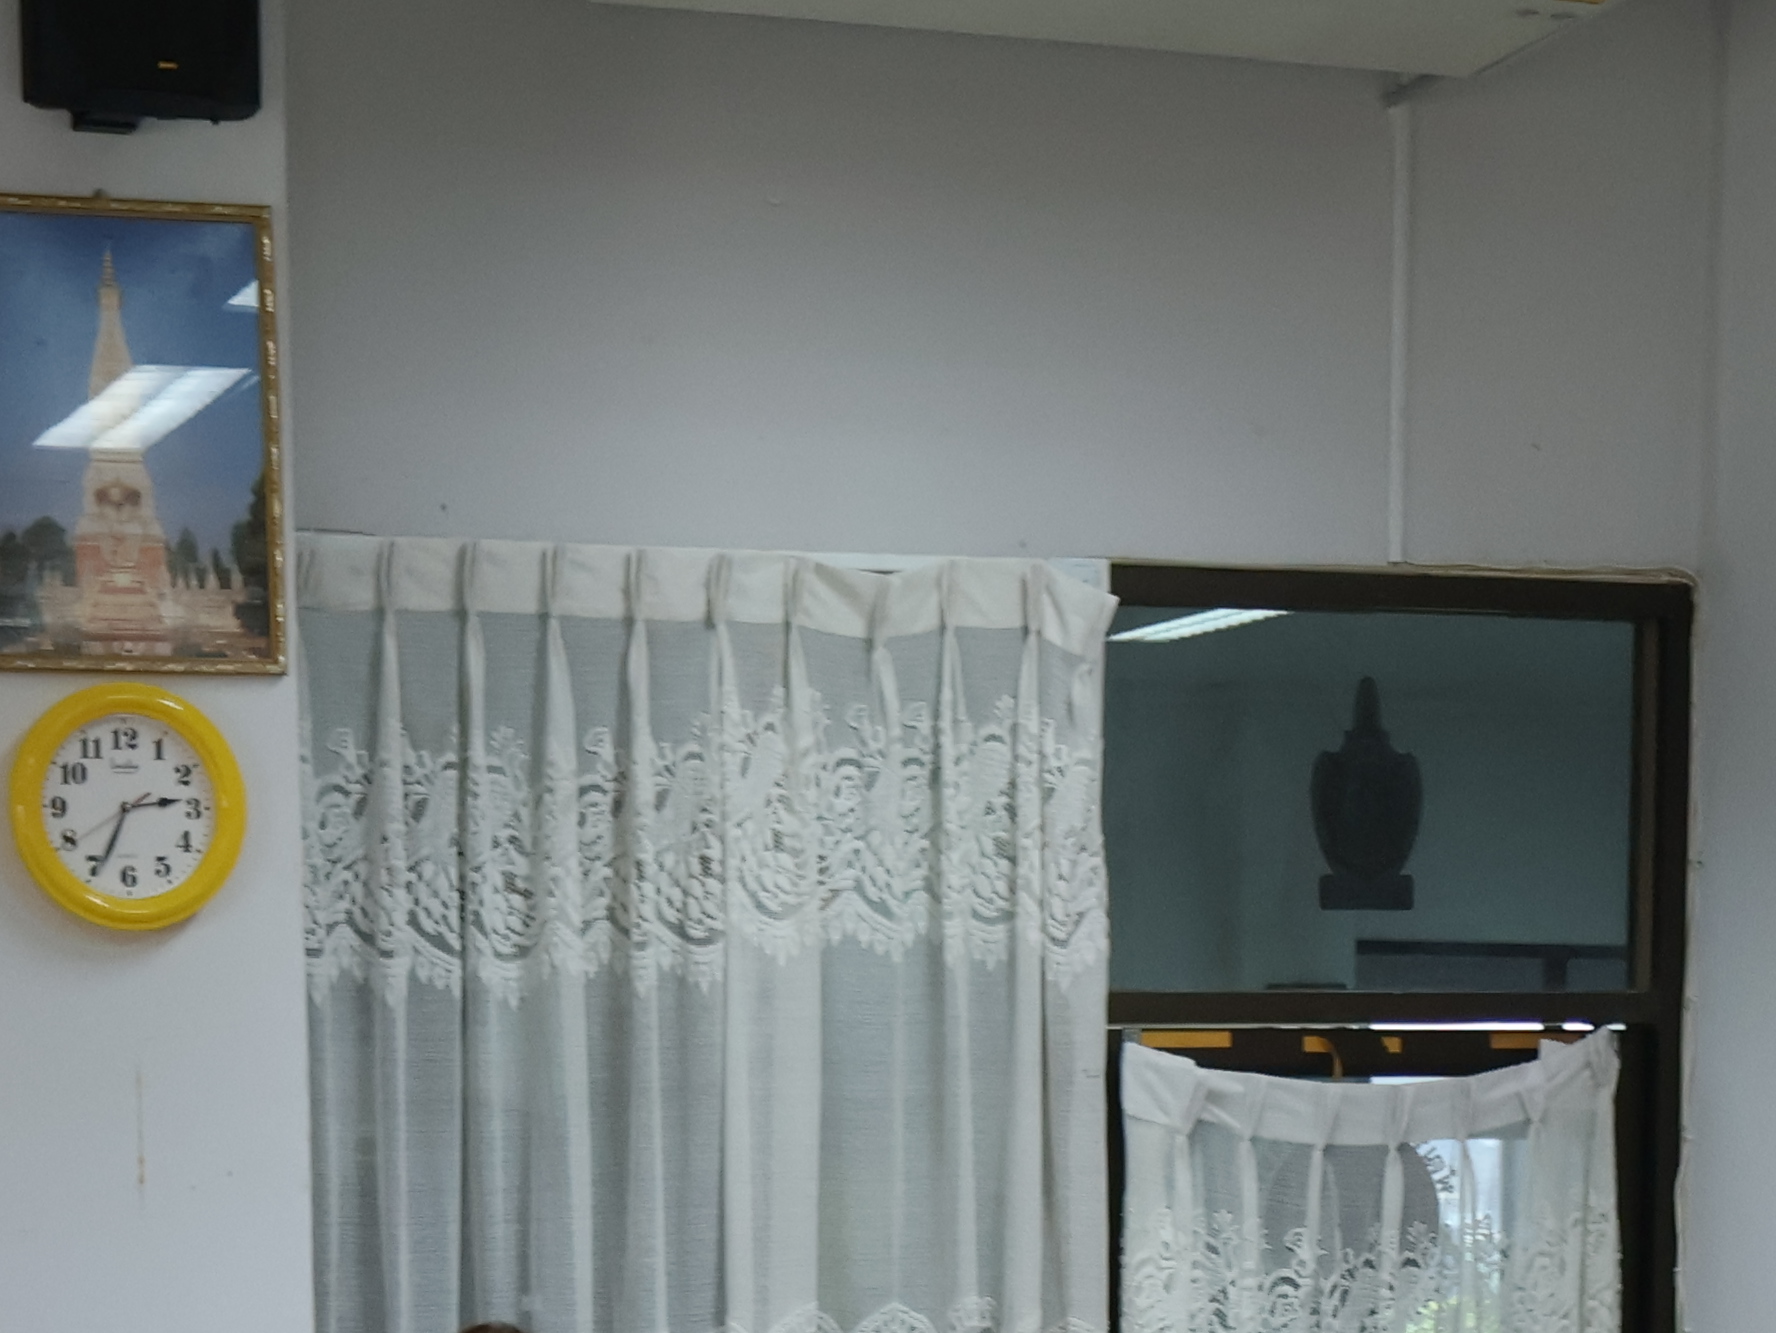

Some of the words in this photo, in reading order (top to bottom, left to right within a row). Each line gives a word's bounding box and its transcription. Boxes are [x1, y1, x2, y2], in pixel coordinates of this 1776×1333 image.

[80, 737, 103, 759] 11
[111, 728, 138, 750] 12
[153, 738, 166, 760] 1
[60, 762, 87, 785] 10
[174, 765, 192, 786] 2
[51, 796, 67, 818] 9
[185, 798, 201, 820] 3
[61, 830, 77, 850] 8
[176, 831, 192, 852] 4
[85, 855, 104, 877] 7
[121, 866, 137, 887] 6
[155, 856, 171, 877] 5
